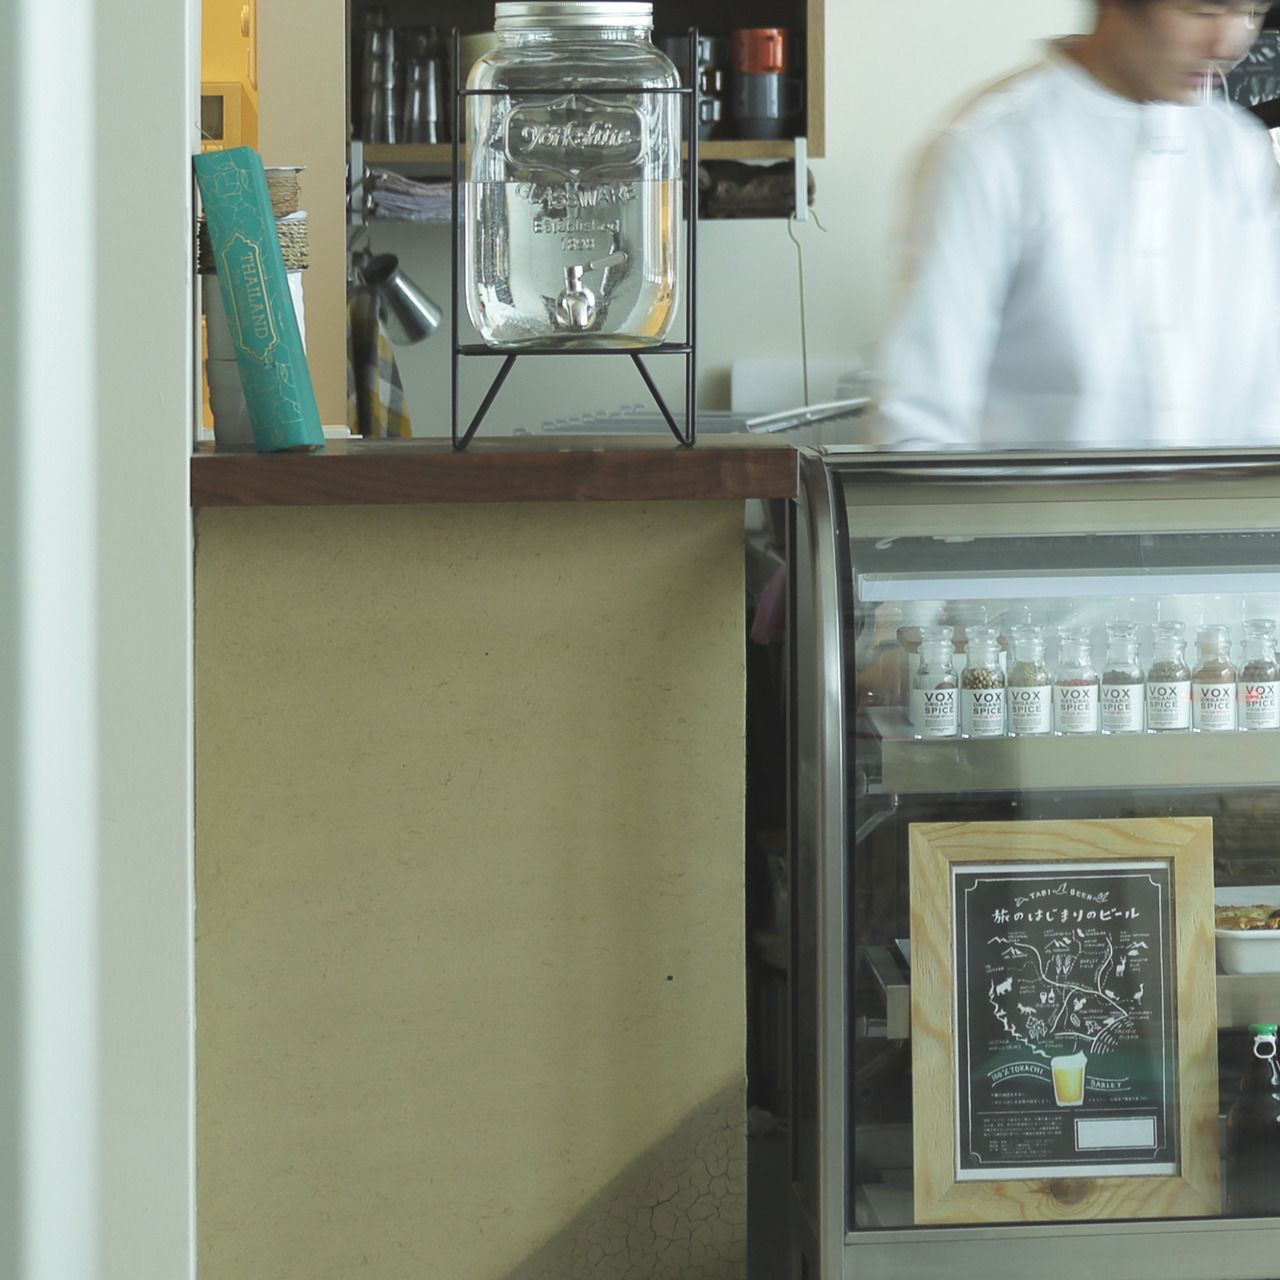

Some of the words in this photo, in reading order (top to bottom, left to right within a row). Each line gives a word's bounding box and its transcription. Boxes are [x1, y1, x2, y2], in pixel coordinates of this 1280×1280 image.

[515, 182, 638, 209] GLASSWARE
[240, 252, 268, 338] THAILAND
[1061, 689, 1090, 698] VOX
[1103, 689, 1130, 698] VOX
[1150, 687, 1177, 696] VOX
[1201, 688, 1229, 697] VOX
[1246, 685, 1274, 695] VOX
[925, 693, 954, 702] VOX
[973, 693, 1001, 702] VOX
[1012, 692, 1041, 700] VOX
[1030, 889, 1051, 899] TABI
[1070, 889, 1092, 901] BEER
[992, 908, 1140, 924] 旅のはじまりのビール
[1010, 1065, 1044, 1075] TOKACHI
[1091, 1080, 1122, 1088] BARLEY
